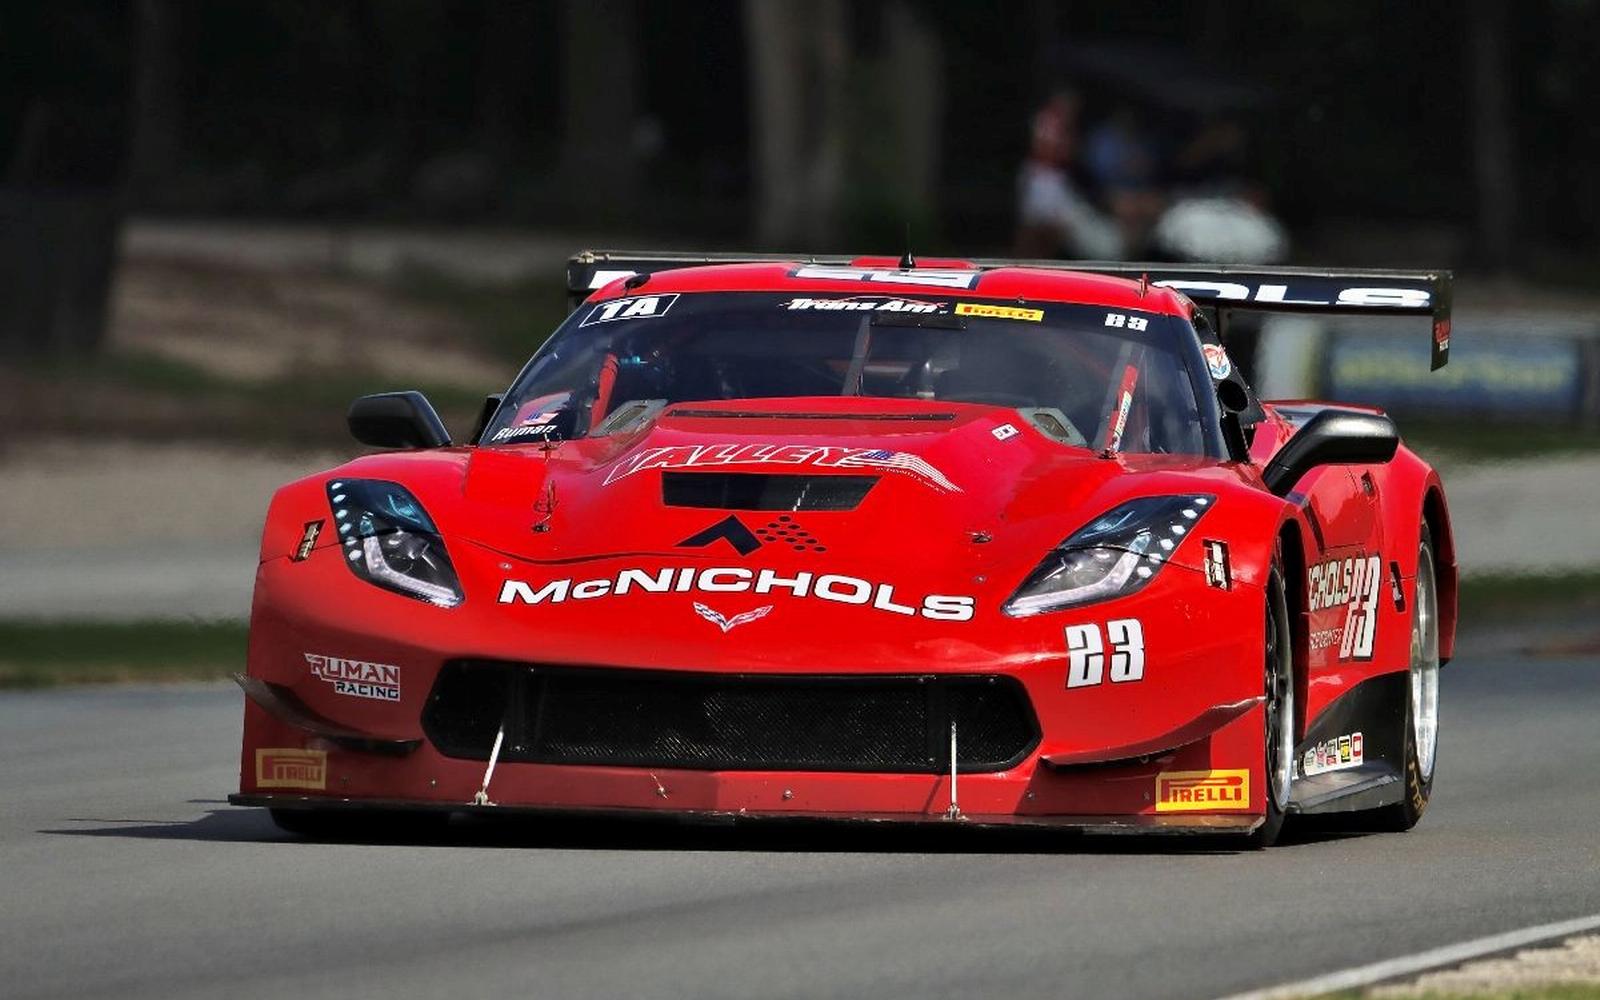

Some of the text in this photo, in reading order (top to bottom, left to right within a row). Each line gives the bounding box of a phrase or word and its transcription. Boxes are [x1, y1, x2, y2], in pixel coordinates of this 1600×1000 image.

[599, 297, 660, 321] TA
[786, 298, 879, 311] Trans
[497, 566, 976, 623] McNICHOLS
[1064, 617, 1146, 690] 23
[306, 655, 400, 684] RUMAN
[335, 681, 399, 699] RACING
[1161, 776, 1243, 803] PIRELLI
